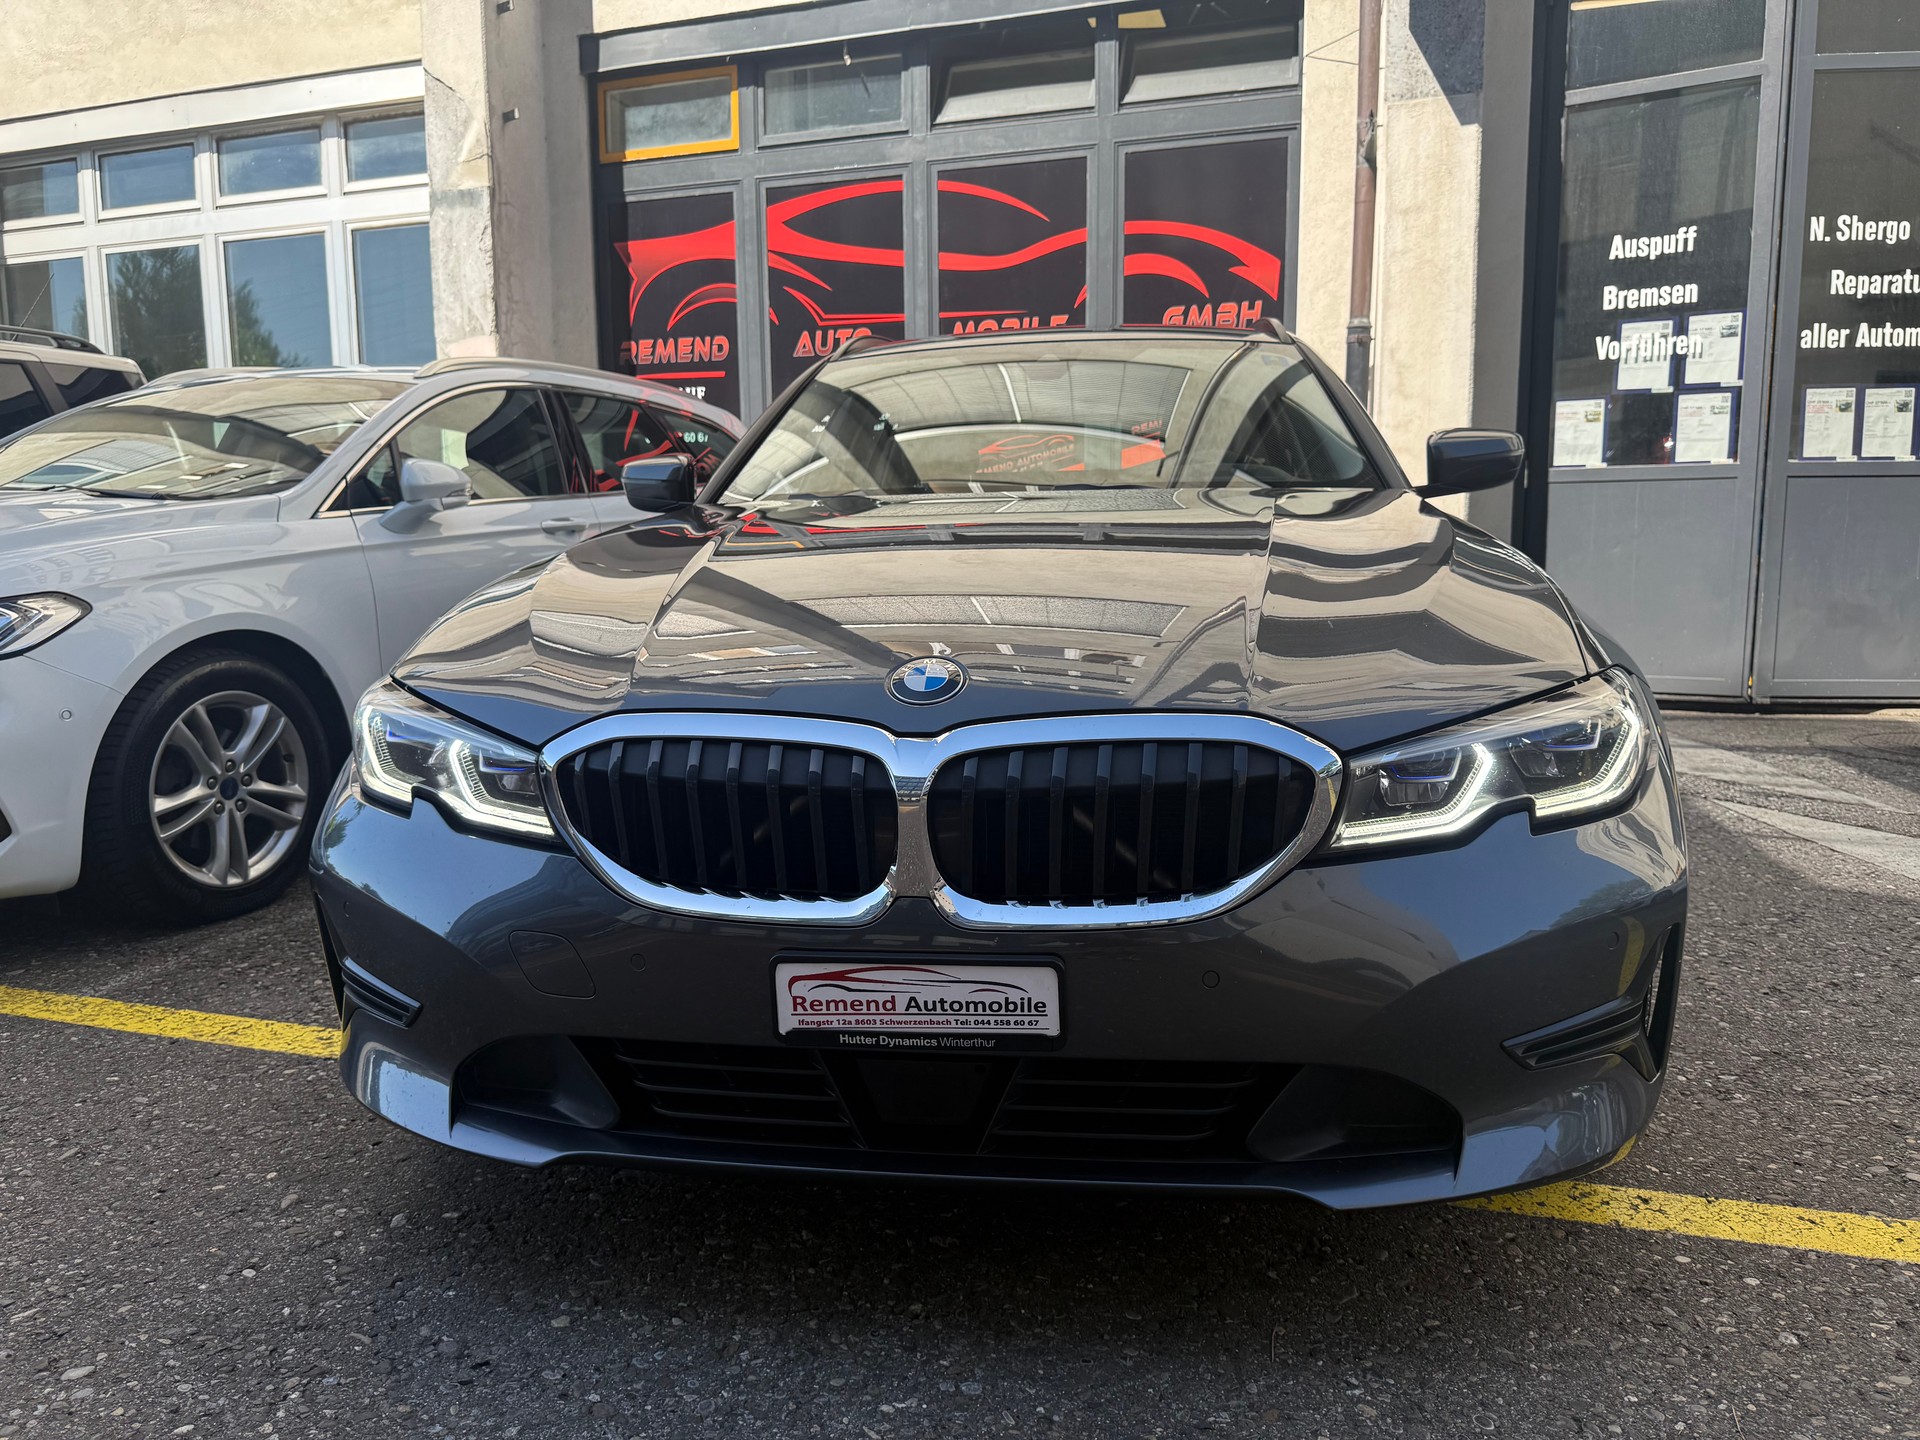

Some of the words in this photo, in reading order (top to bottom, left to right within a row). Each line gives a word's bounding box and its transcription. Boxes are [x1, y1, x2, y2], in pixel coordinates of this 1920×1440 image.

[1609, 225, 1698, 260] Auspuff
[1809, 216, 1831, 242] N.
[1836, 214, 1912, 244] Shergo
[1602, 283, 1699, 310] Bremsen
[1830, 268, 1920, 299] Reparatu
[620, 336, 730, 365] REMEND
[1162, 300, 1262, 327] GMBH
[1595, 331, 1703, 361] Vorführen
[1800, 322, 1851, 349] aller
[1855, 322, 1920, 348] Autom
[792, 995, 897, 1012] Remend
[905, 996, 1047, 1013] Automobile
[879, 1019, 952, 1027] Schwerzenbach
[973, 1019, 991, 1027] 044
[993, 1019, 1012, 1027] 558
[1013, 1019, 1026, 1027] 60
[1027, 1019, 1040, 1027] 67
[839, 1034, 877, 1045] Hutter
[879, 1035, 938, 1047] Dynamics
[939, 1036, 996, 1047] Winterthur
